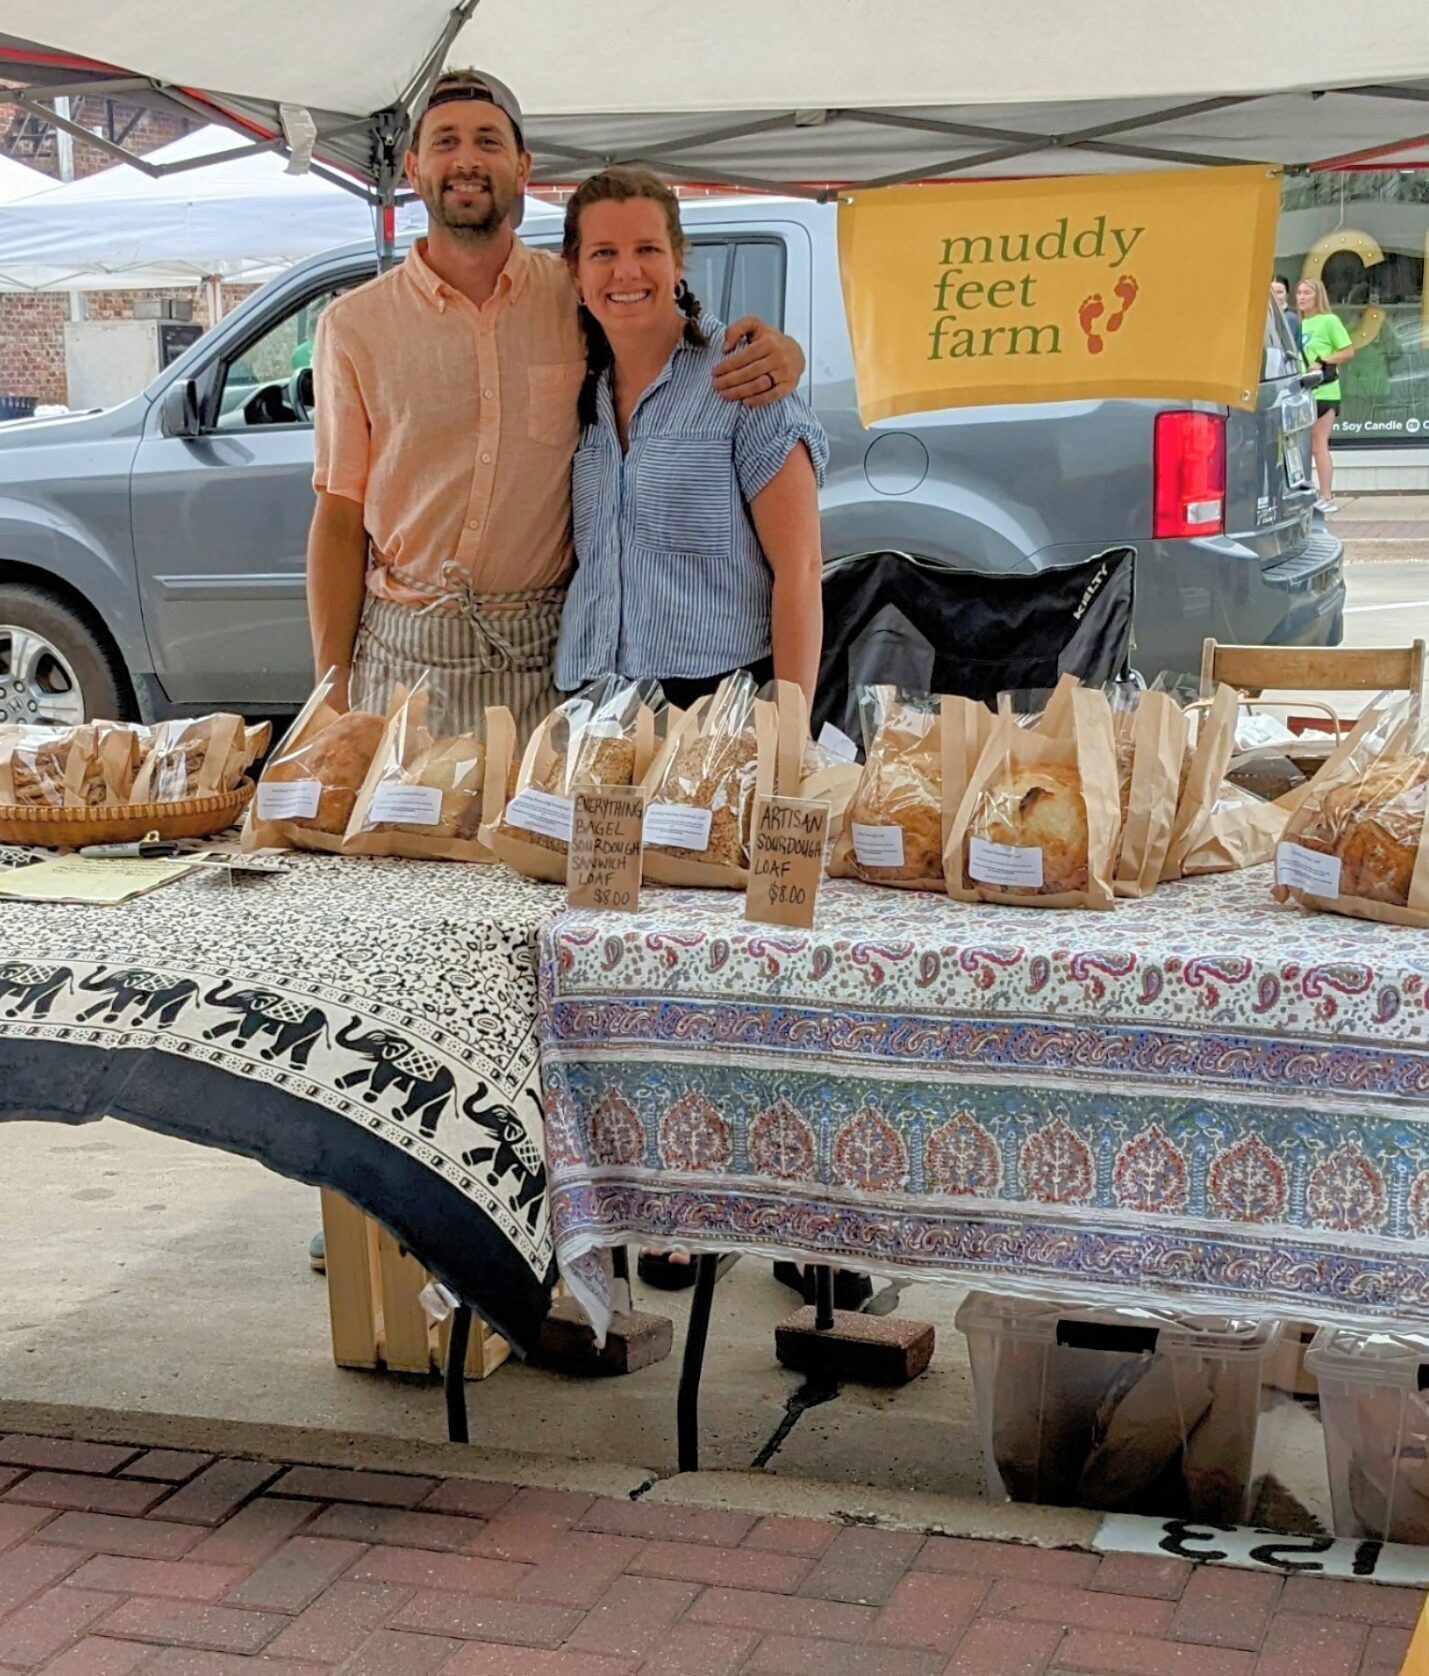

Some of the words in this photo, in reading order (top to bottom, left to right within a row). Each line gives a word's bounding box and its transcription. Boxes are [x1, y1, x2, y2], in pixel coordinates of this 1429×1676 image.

[938, 215, 1146, 268] muddy
[932, 268, 1038, 311] feet
[927, 315, 1062, 361] farm
[1342, 421, 1363, 433] Soy
[1364, 420, 1403, 431] Candle
[1073, 562, 1108, 620] KELTY
[575, 794, 643, 819] EVERYTHING
[575, 819, 625, 837] BAGEL
[760, 805, 823, 834] ARTISAN
[571, 837, 641, 856] SOURDOUGH
[757, 832, 823, 858] SOURDOUGH
[578, 872, 616, 887] LOAF
[754, 859, 792, 877] LOAF
